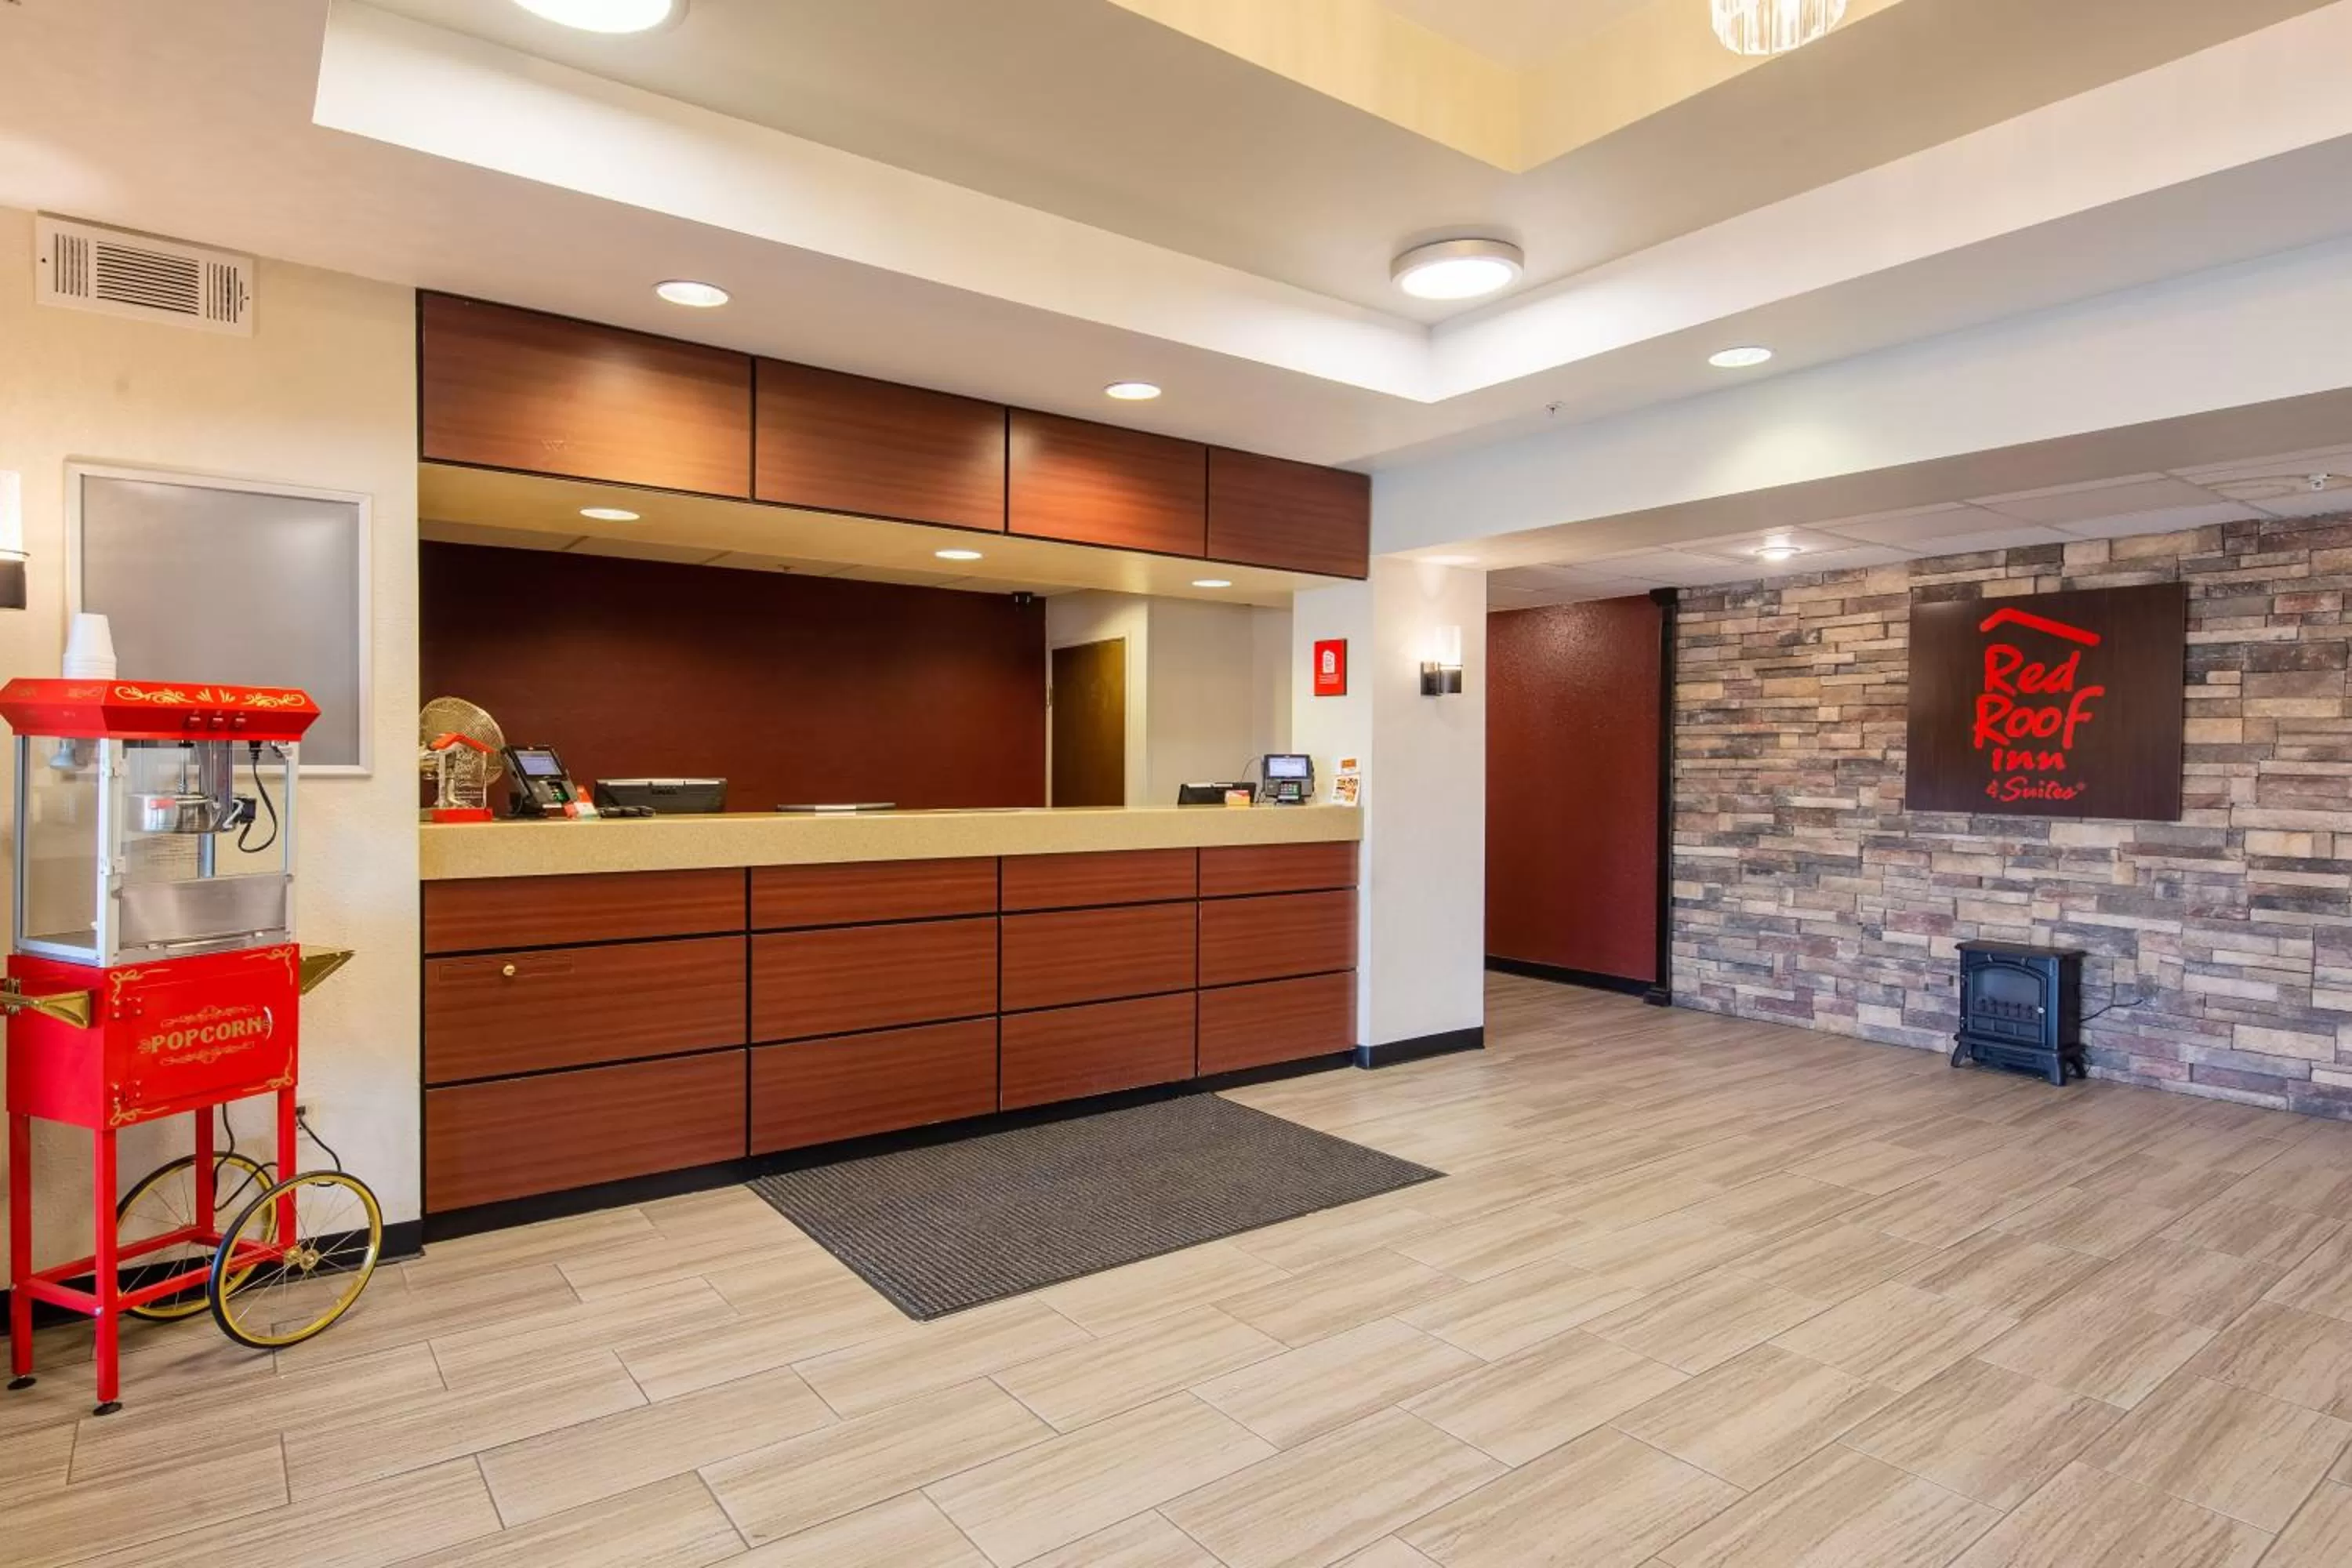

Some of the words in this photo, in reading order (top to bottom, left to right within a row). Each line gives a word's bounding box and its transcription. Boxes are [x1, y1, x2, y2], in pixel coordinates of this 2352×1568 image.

[1984, 644, 2082, 697] Red
[1973, 686, 2106, 750] Roof
[150, 1015, 263, 1054] POPCORN
